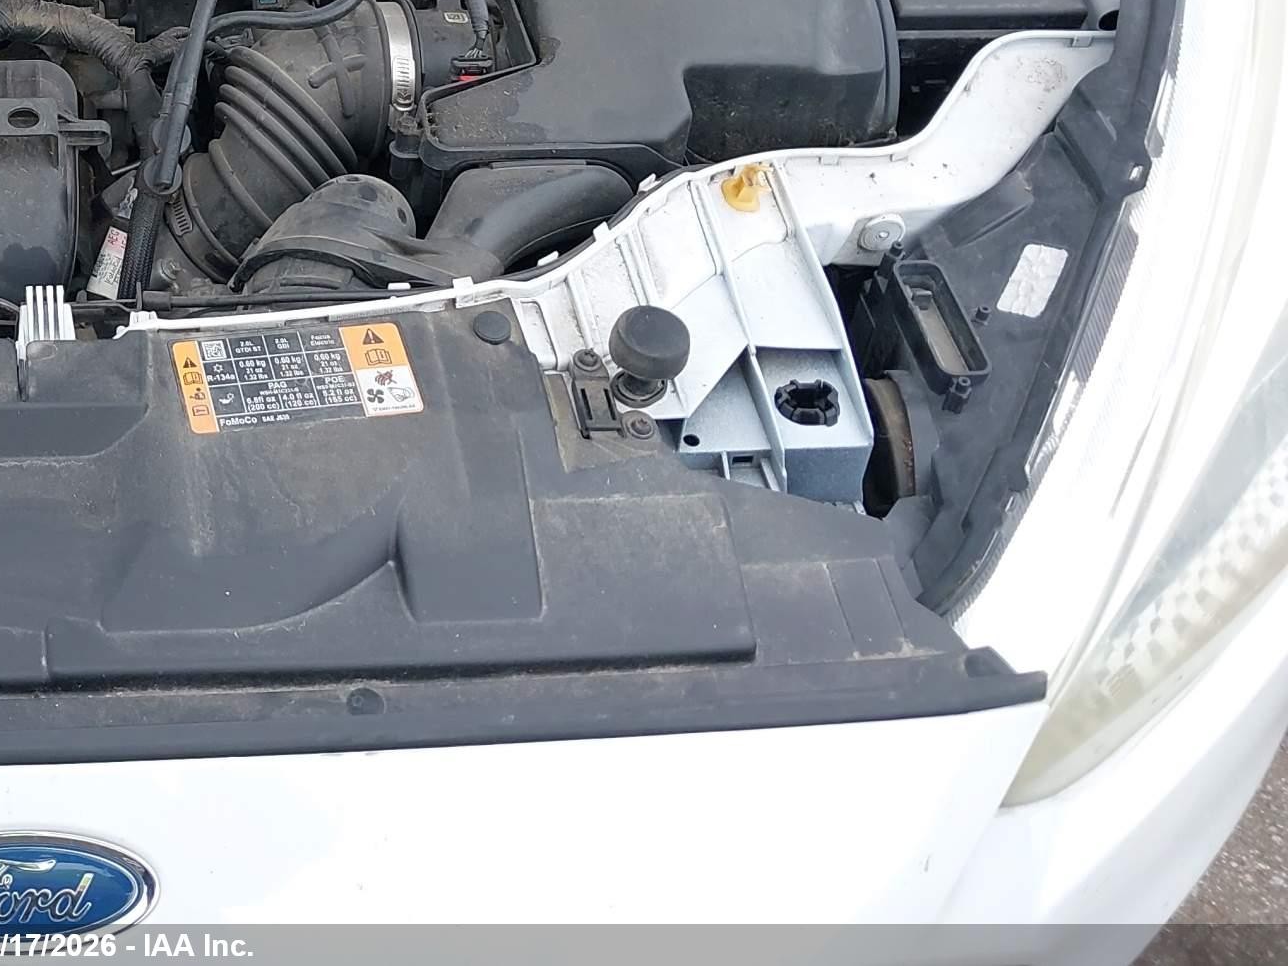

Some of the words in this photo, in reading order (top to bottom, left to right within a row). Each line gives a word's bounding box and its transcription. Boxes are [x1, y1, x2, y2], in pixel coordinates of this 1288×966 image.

[256, 360, 266, 368] kg
[291, 356, 301, 364] kg
[207, 373, 235, 382] R-134a
[325, 376, 345, 384] POE
[268, 381, 288, 389] PAG
[282, 393, 295, 401] 4.0
[344, 394, 357, 402] cc)
[304, 398, 317, 407] cc)
[248, 403, 265, 412] (200
[267, 402, 280, 410] cc)
[219, 416, 258, 426] FoMoCo
